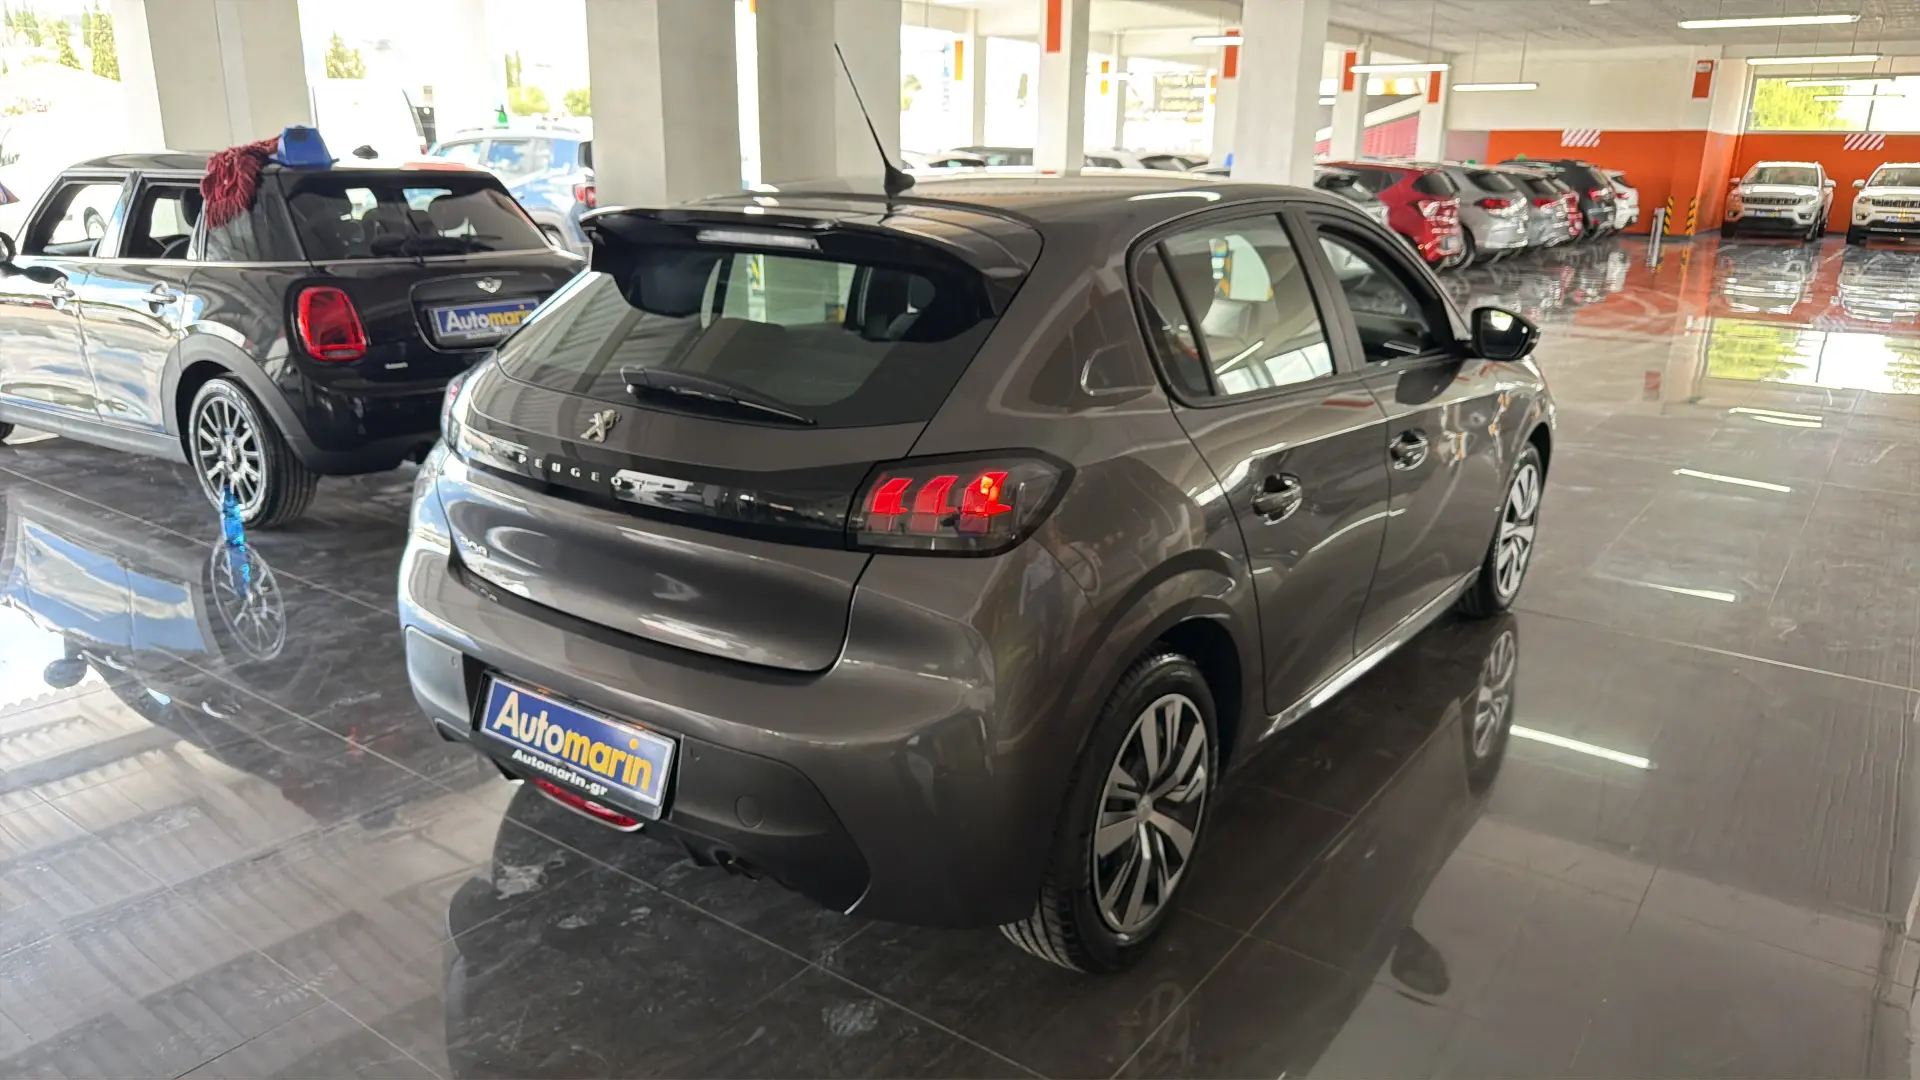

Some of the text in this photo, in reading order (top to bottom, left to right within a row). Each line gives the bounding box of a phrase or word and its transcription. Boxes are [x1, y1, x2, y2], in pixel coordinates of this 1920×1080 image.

[447, 304, 531, 332] Automari
[493, 691, 652, 791] Automarin
[512, 749, 608, 796] Automarin.gr
